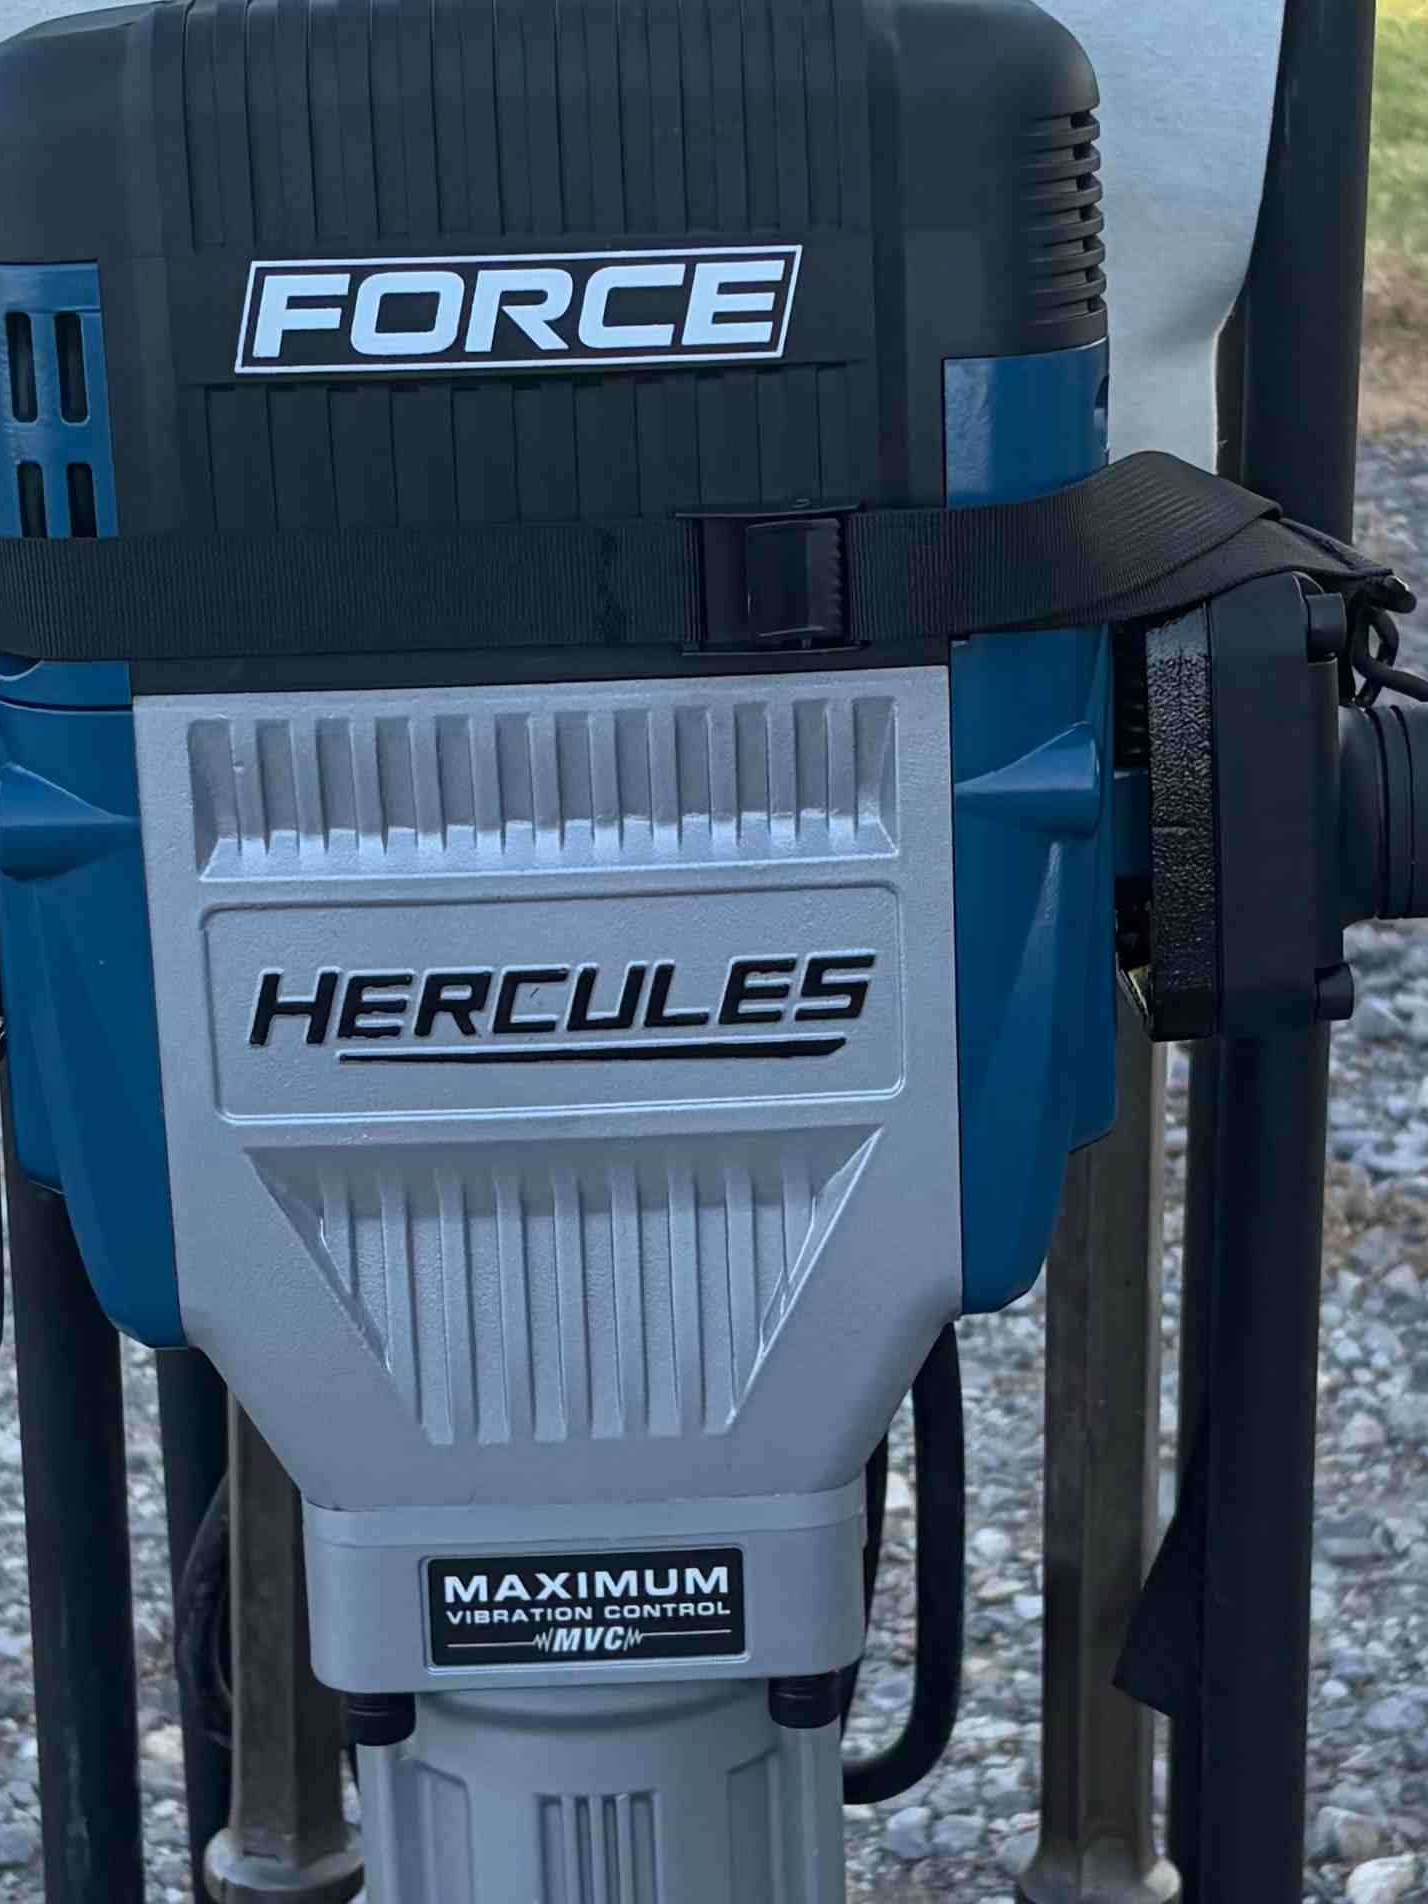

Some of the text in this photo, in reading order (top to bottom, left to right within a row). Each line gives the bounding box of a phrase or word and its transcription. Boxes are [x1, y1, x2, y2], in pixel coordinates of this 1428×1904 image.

[252, 259, 785, 358] FORCE
[248, 950, 876, 1046] HERCULES
[443, 1566, 729, 1603] MAXIMUM
[445, 1601, 731, 1625] VIBRATION CONTROL
[551, 1626, 625, 1652] MVC
